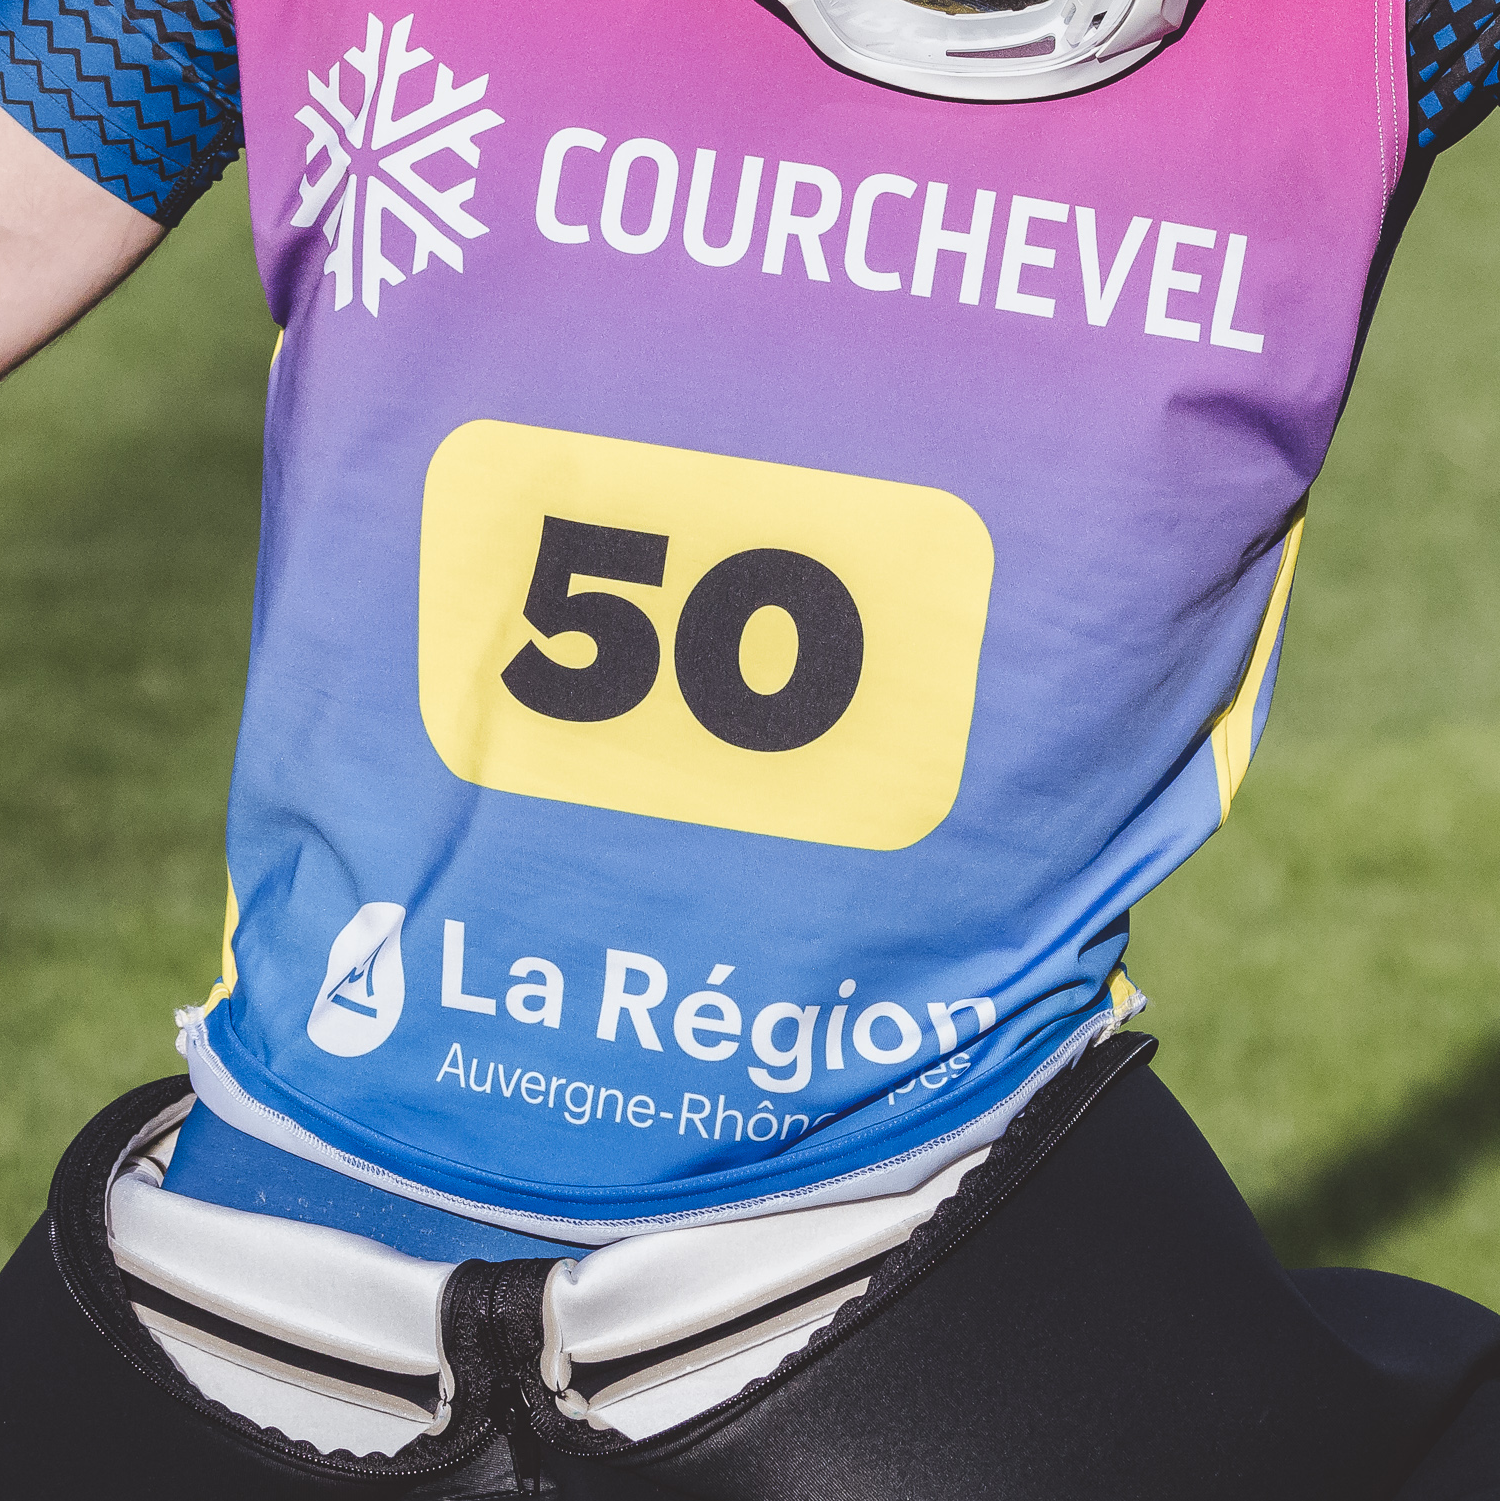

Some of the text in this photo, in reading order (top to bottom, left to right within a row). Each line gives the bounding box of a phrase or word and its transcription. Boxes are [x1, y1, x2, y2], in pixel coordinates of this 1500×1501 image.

[535, 126, 1266, 354] COURCHEVEL
[500, 514, 865, 753] 50
[440, 917, 997, 1094] La Région
